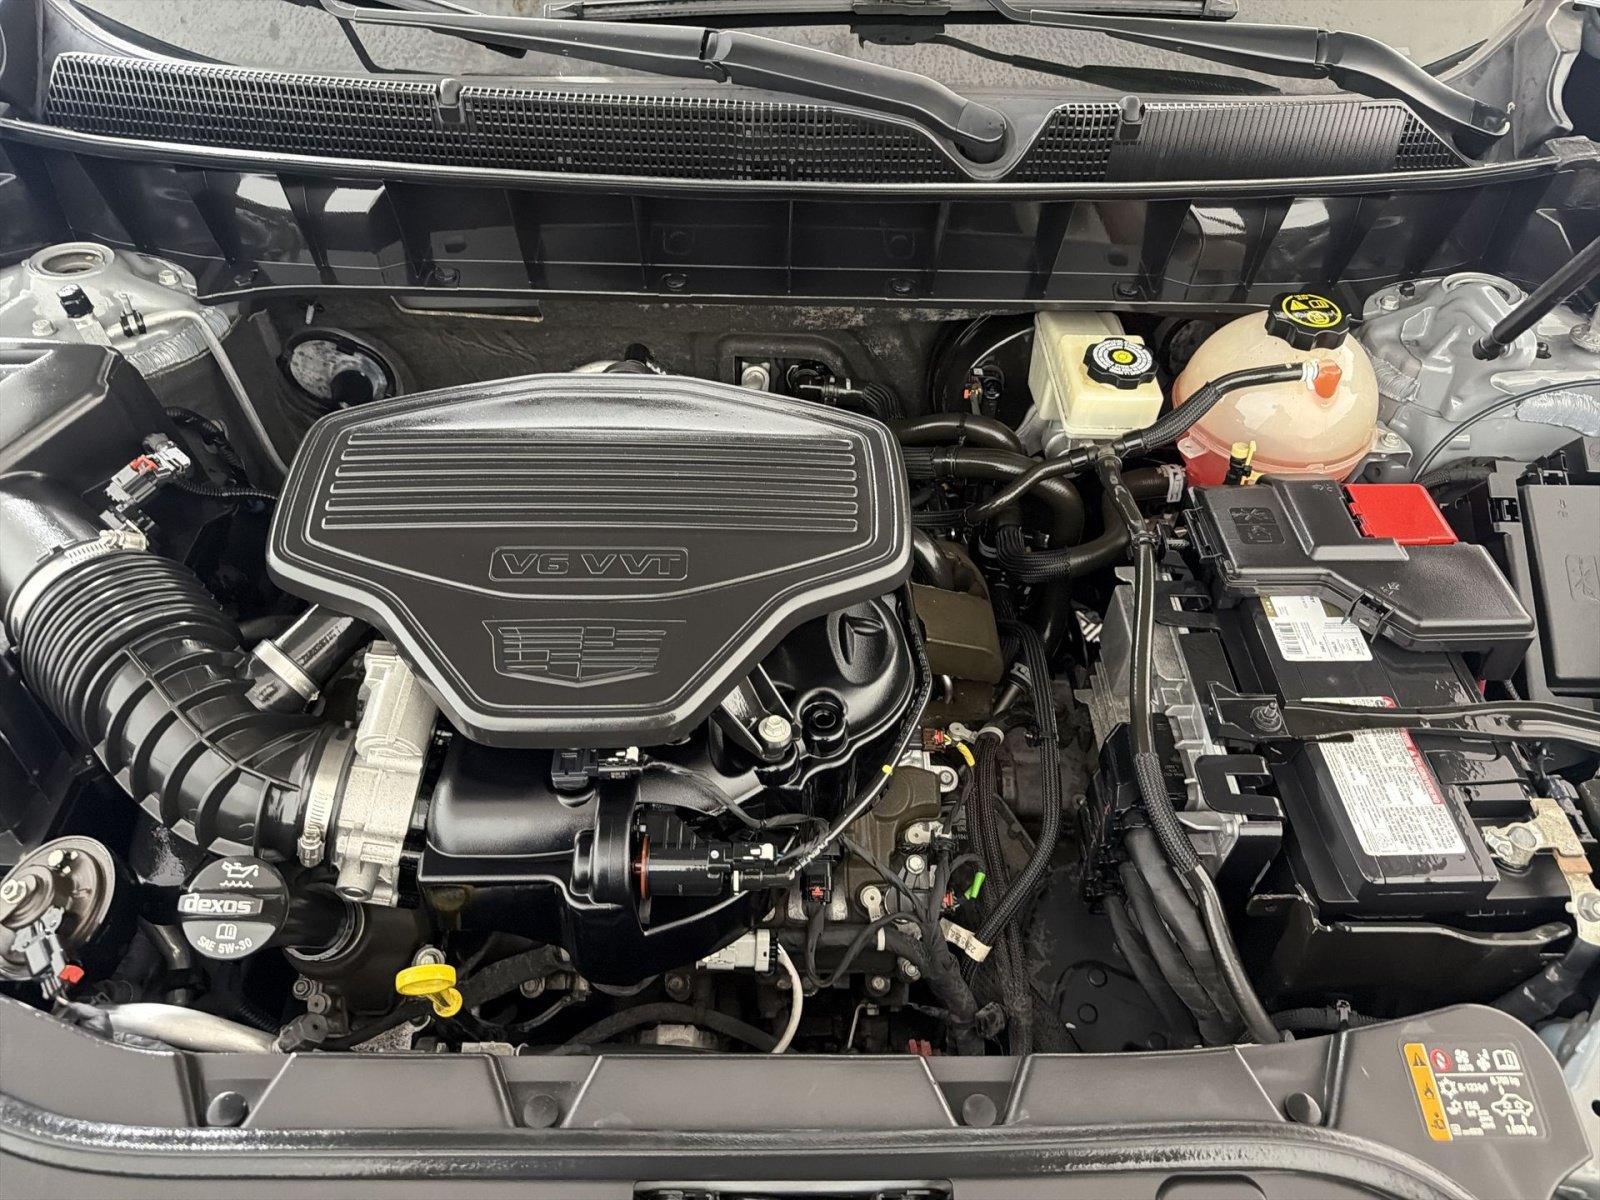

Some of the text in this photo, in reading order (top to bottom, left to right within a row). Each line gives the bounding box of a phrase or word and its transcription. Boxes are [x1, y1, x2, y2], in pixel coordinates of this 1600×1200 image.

[501, 553, 682, 575] V6 VVT
[184, 893, 252, 913] dexos
[197, 935, 253, 954] SAE 5W-30
